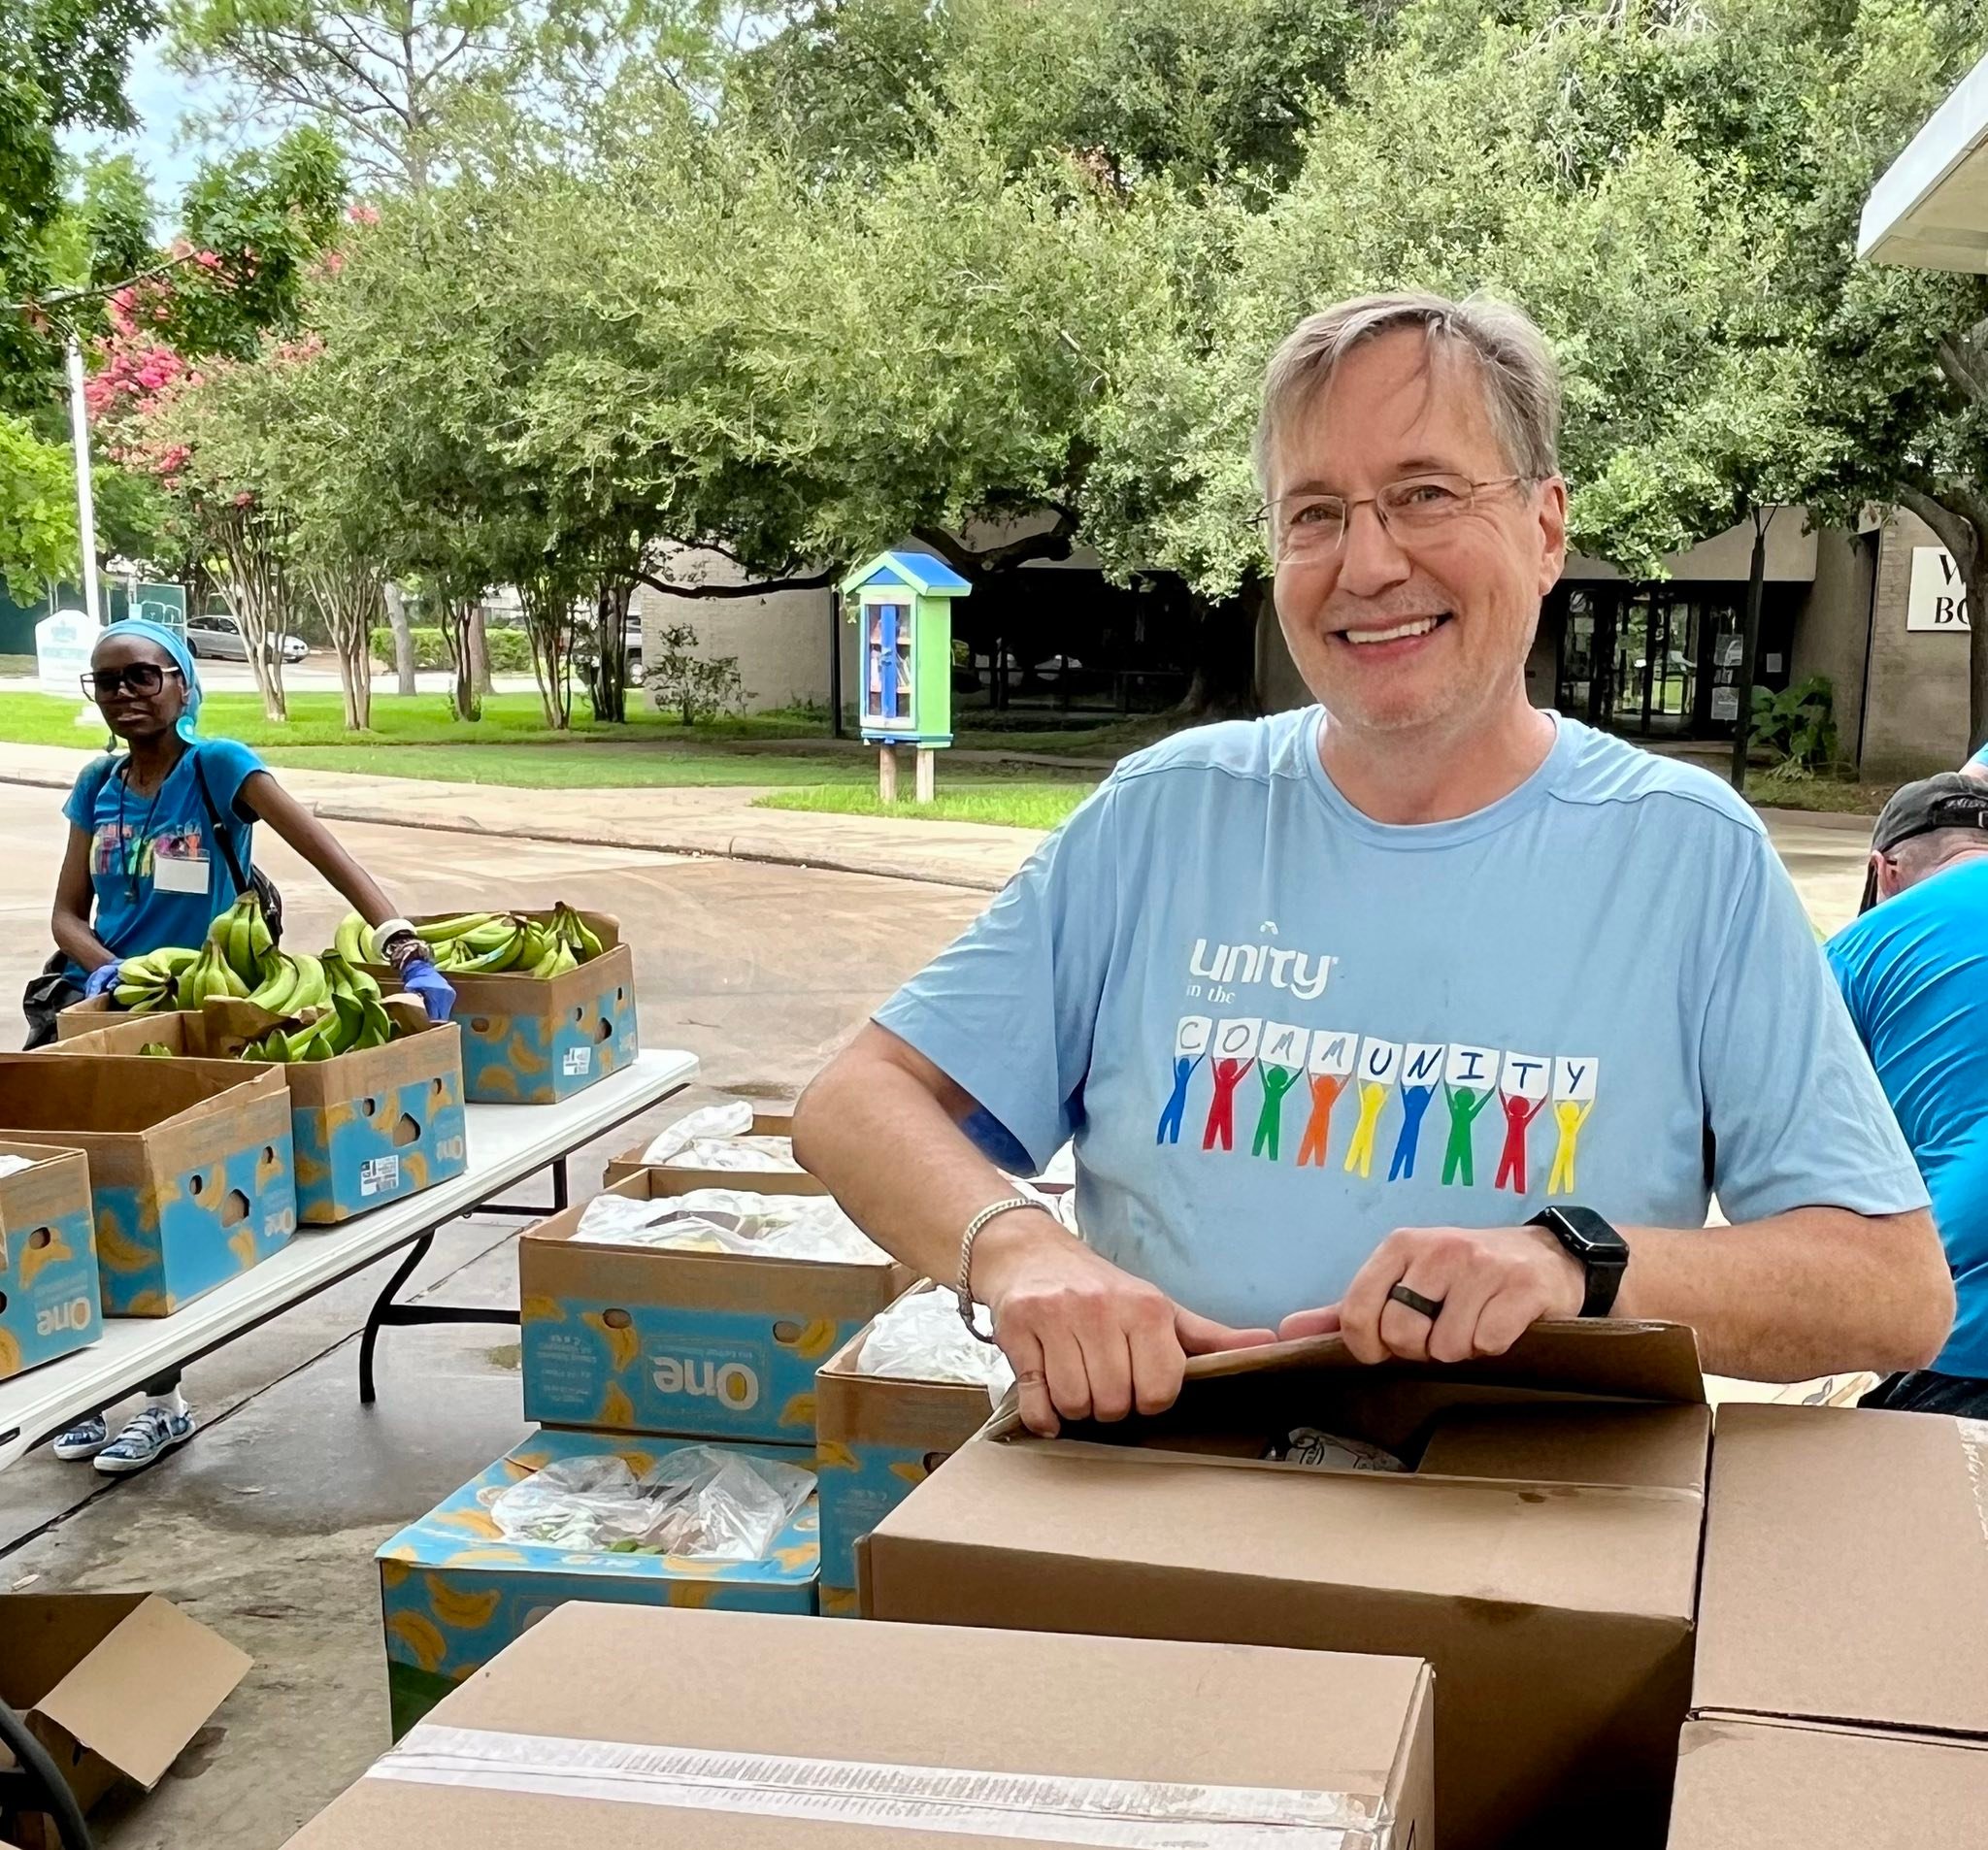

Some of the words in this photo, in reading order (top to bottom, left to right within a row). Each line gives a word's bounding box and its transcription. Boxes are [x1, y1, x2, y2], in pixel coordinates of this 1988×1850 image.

[1189, 934, 1332, 1001] unity
[1208, 985, 1236, 1005] the
[1178, 1020, 1587, 1095] COMMUNITY
[650, 1356, 759, 1411] One
